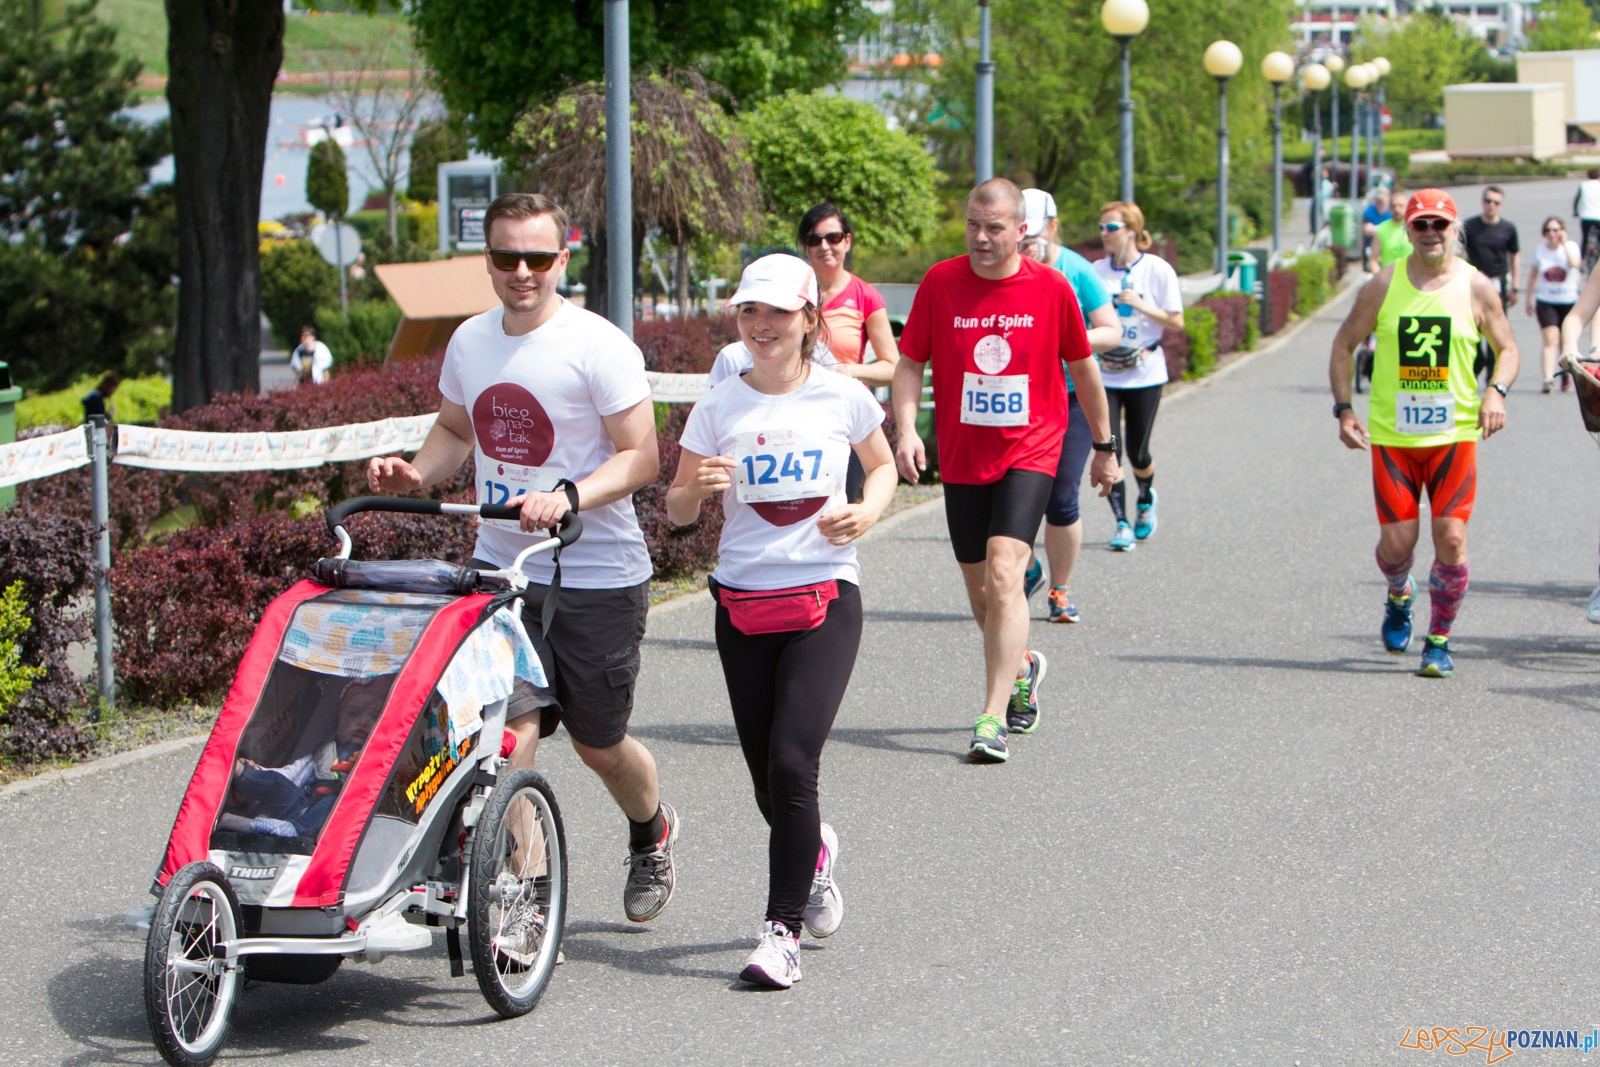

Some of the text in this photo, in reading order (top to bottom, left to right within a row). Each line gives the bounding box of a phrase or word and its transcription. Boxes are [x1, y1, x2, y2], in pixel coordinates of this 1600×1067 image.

[953, 314, 1034, 331] Run of Spirit
[980, 343, 1005, 357] Bieg
[1408, 367, 1441, 380] night
[1400, 380, 1449, 389] runners
[966, 390, 1023, 414] 1568
[492, 396, 534, 428] bieg
[1403, 405, 1447, 424] 1123
[507, 419, 522, 429] na
[508, 428, 531, 444] tak
[742, 449, 823, 485] 1247
[231, 866, 277, 878] THULE
